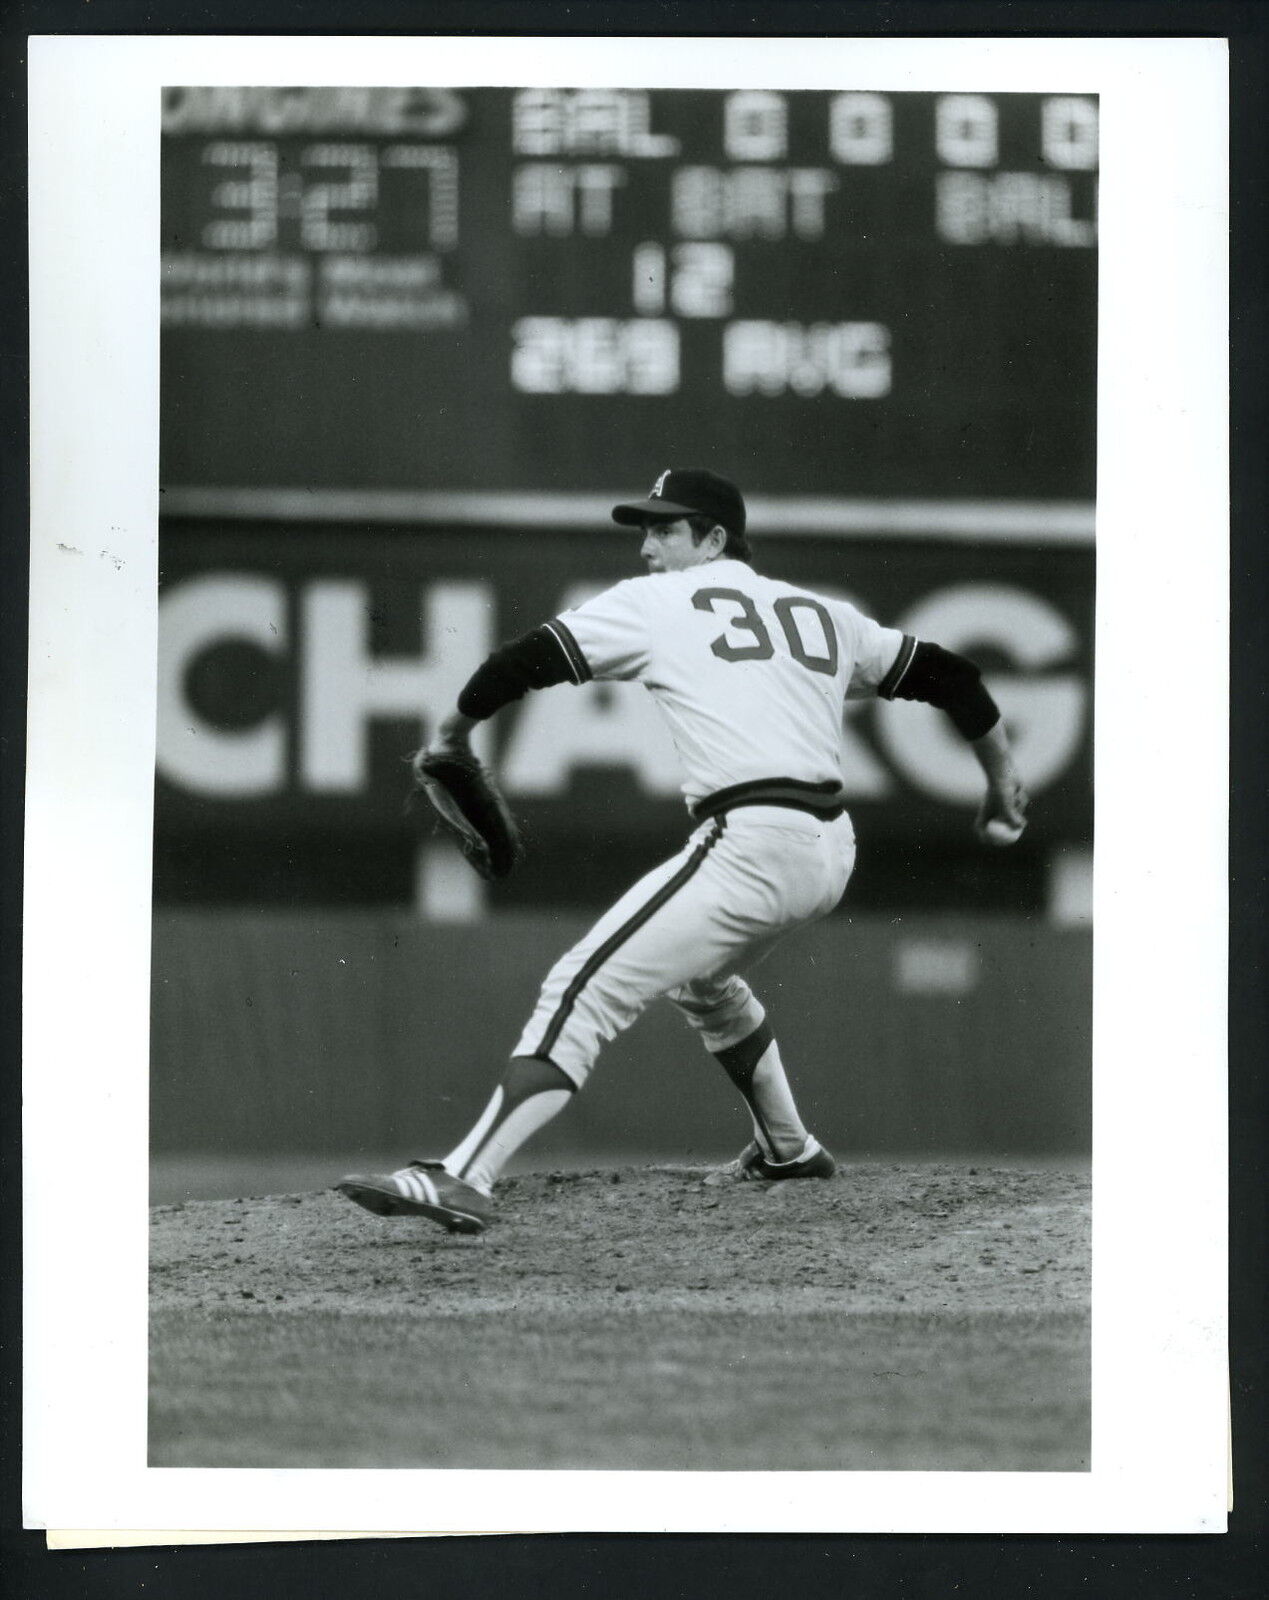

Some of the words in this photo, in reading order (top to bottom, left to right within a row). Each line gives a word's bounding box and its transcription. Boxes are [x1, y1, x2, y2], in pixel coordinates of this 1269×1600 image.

[724, 92, 788, 160] 0
[830, 93, 893, 165] 0
[935, 94, 999, 168] 0
[1041, 96, 1098, 170] 0
[633, 243, 734, 318] 12
[691, 587, 838, 677] 30
